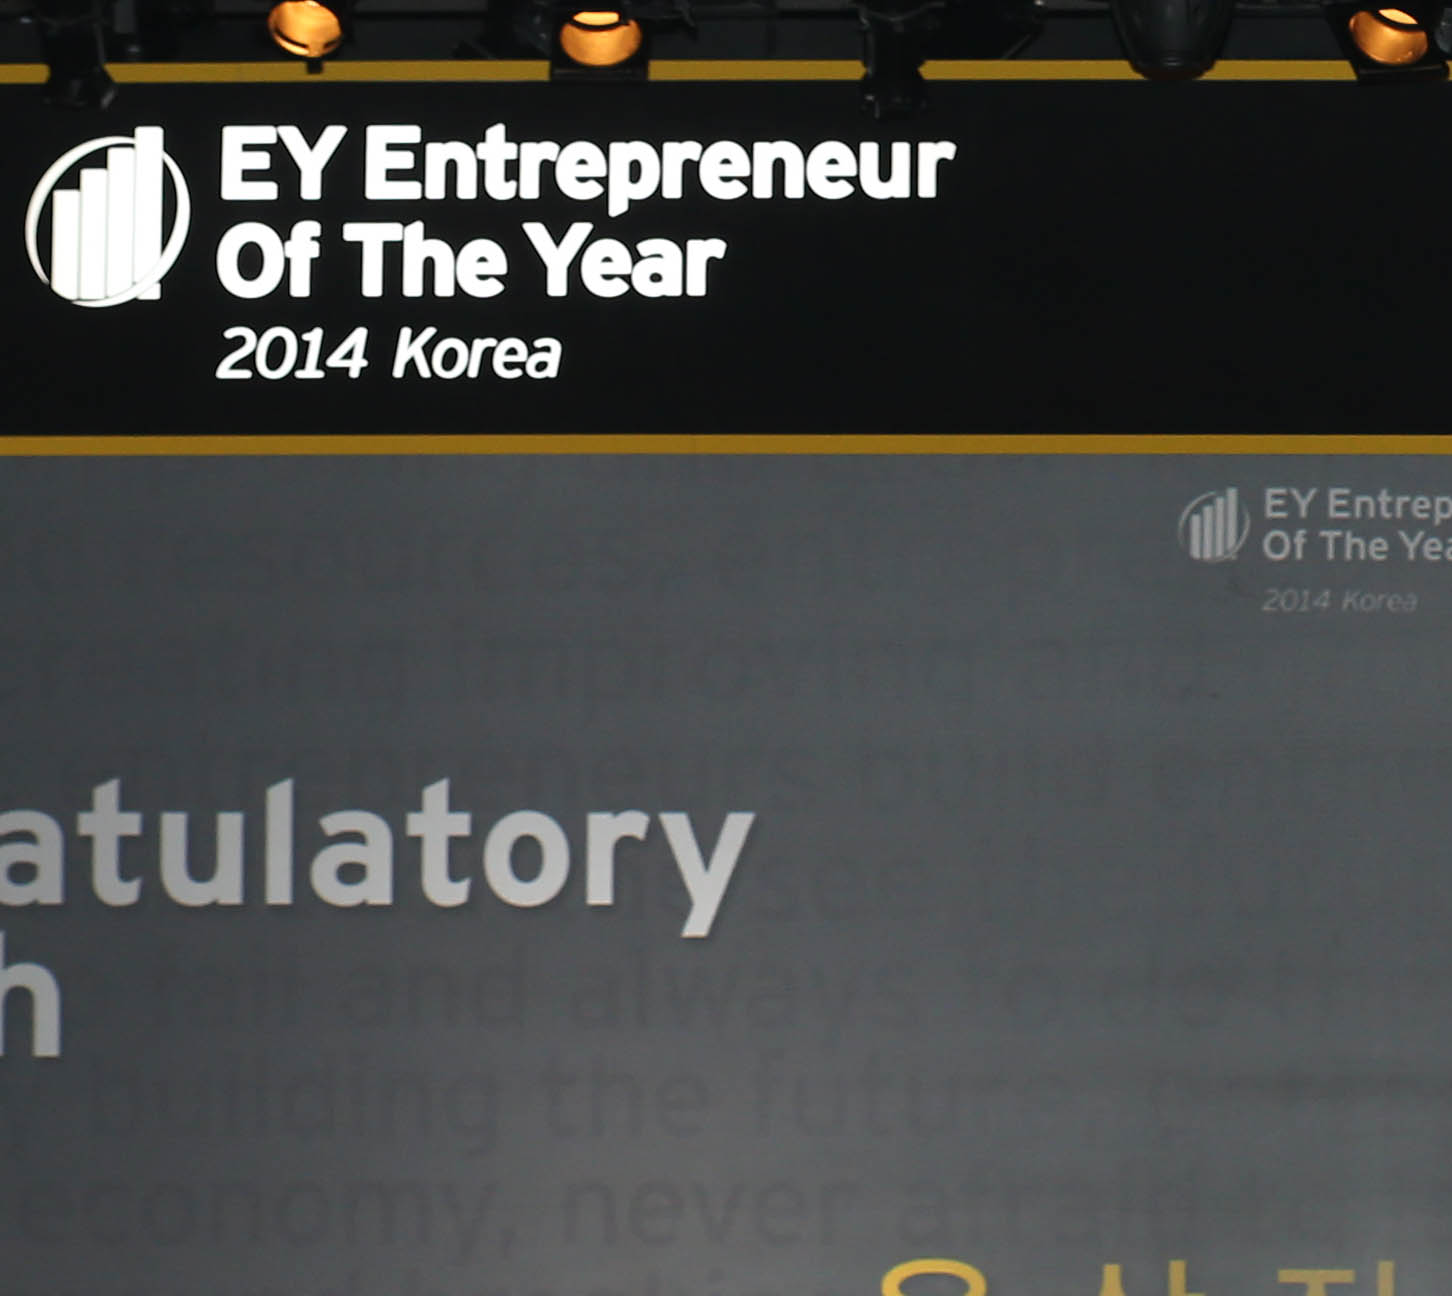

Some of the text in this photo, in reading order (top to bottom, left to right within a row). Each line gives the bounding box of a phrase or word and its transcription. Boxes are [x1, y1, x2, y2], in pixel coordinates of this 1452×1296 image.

[221, 123, 958, 219] EY Entrepreneur
[217, 220, 728, 300] Of The Year
[216, 327, 563, 381] 2014 Korea
[1266, 488, 1318, 519] EY
[1263, 529, 1308, 562] Of
[1320, 530, 1390, 562] The
[1264, 590, 1420, 613] 2014 Korea
[0, 779, 757, 939] atulatory
[540, 1056, 711, 1138] the
[562, 1175, 862, 1248] never
